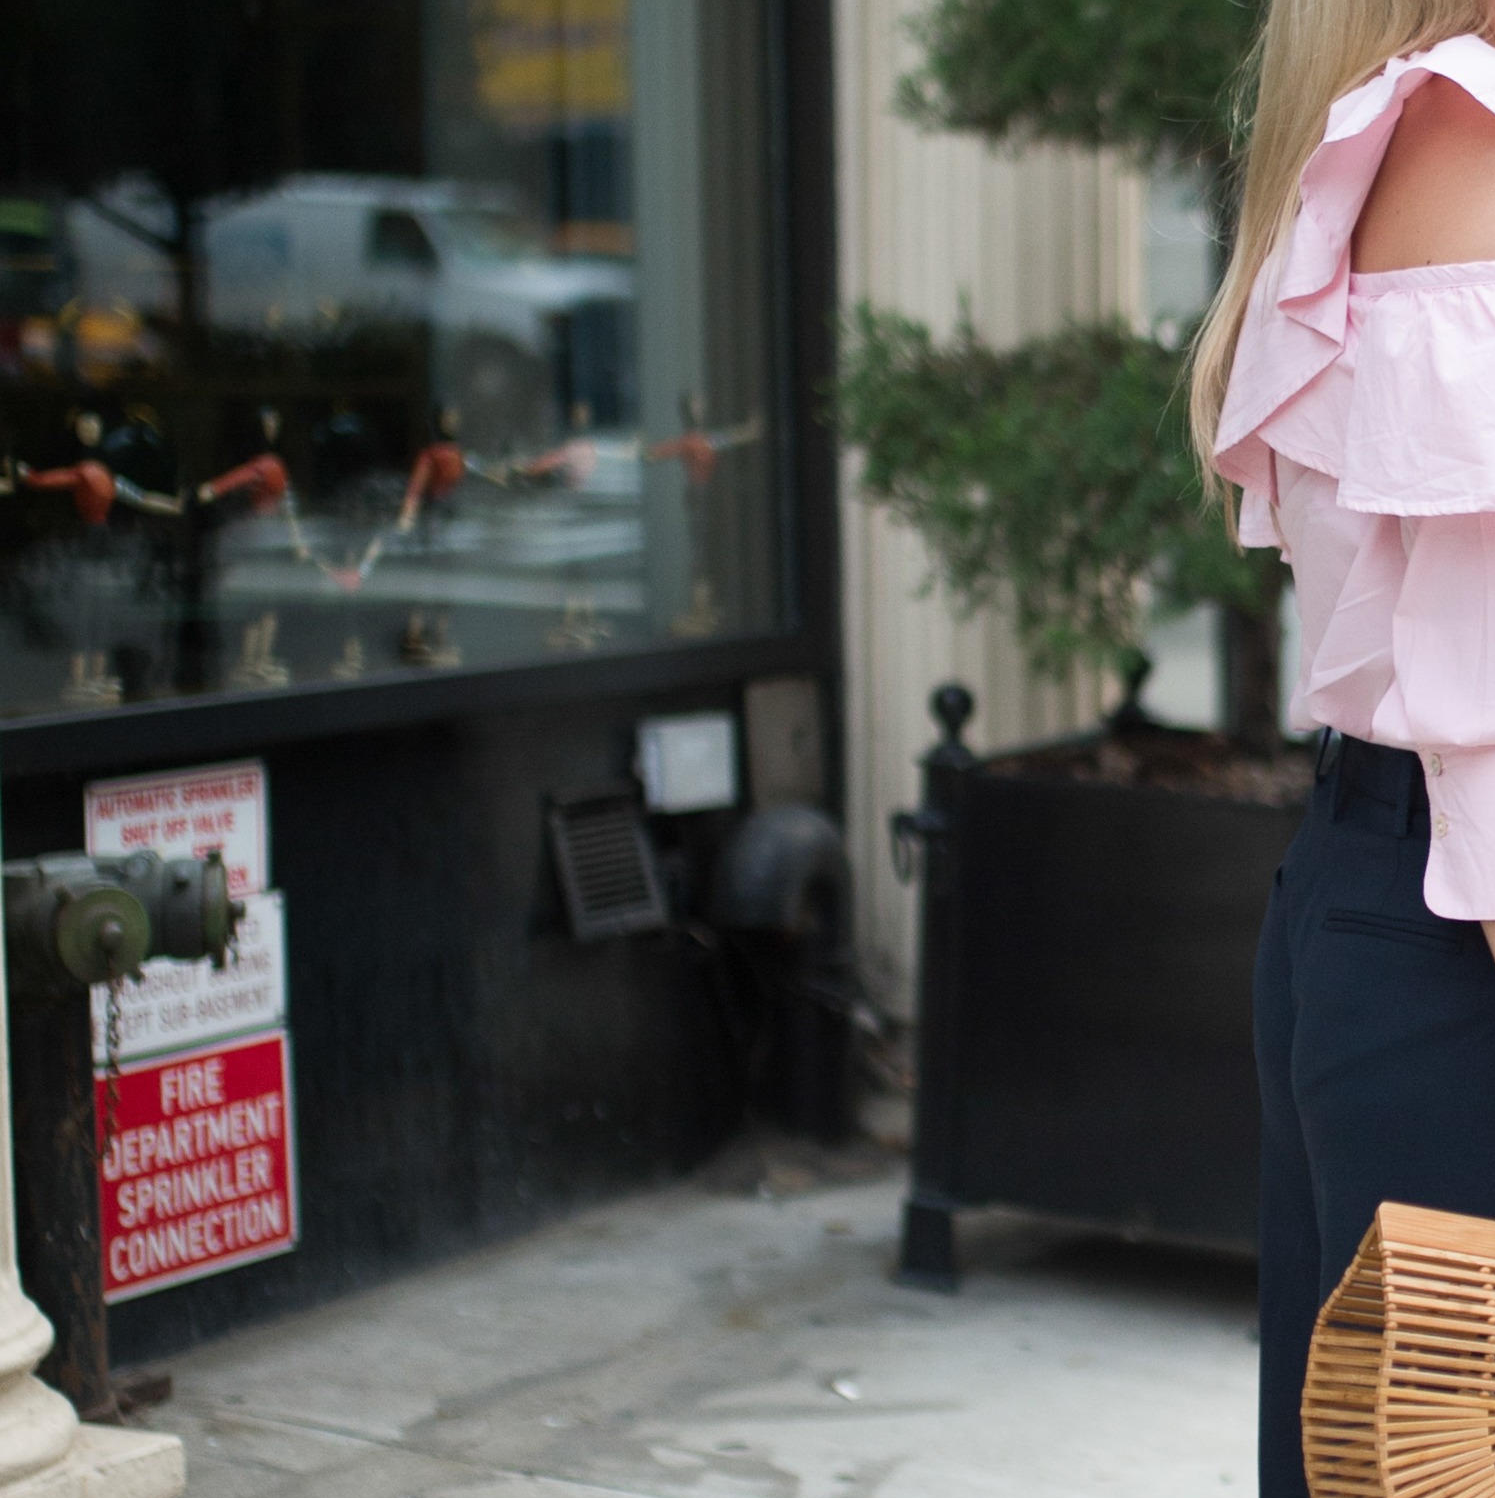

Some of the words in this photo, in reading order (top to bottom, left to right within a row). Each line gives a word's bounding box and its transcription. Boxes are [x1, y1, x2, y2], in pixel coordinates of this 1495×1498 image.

[97, 789, 177, 821] AUTOMATIC
[181, 777, 254, 805] SPRINKLER
[122, 819, 157, 847] SHUT
[163, 816, 188, 842] OFF
[191, 809, 234, 834] VALVE
[160, 1057, 225, 1116] FIRE
[102, 1091, 281, 1182] DEPARTMENT
[117, 1144, 273, 1229] SPRINKLER
[109, 1191, 284, 1282] CONNECTION
